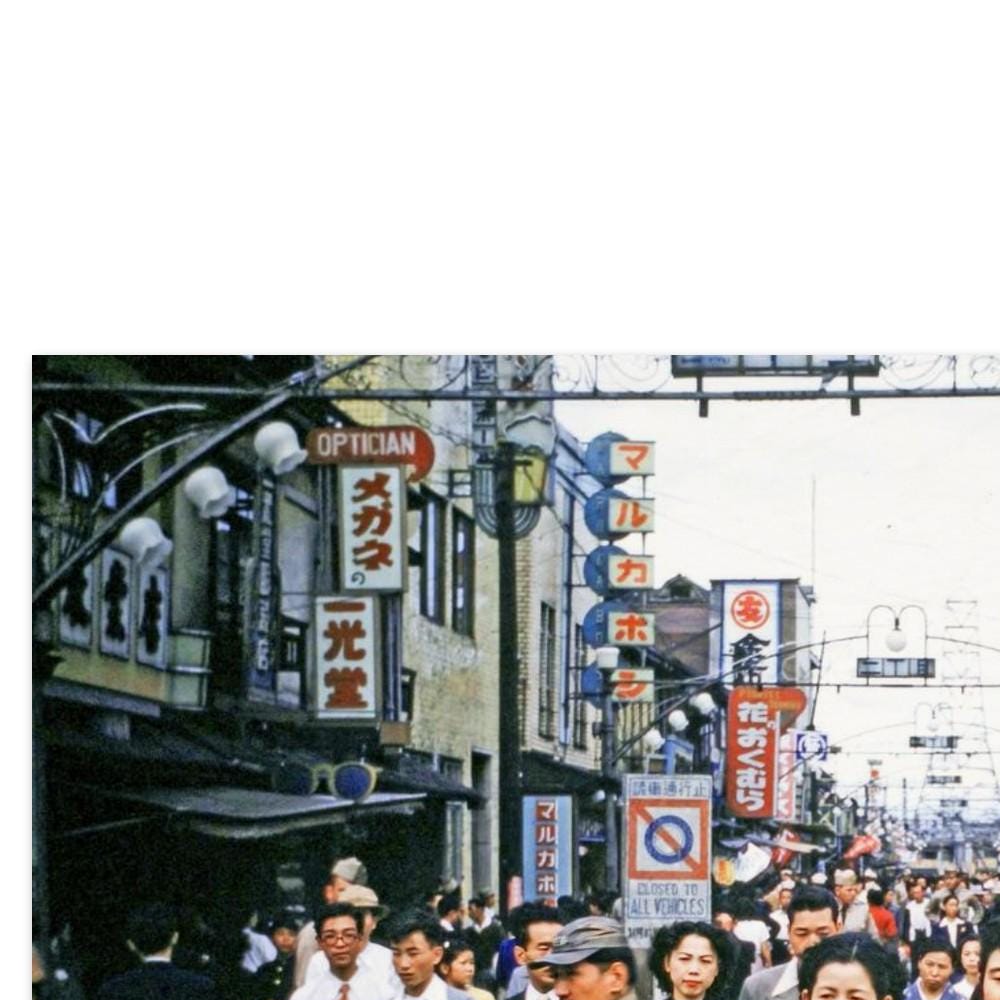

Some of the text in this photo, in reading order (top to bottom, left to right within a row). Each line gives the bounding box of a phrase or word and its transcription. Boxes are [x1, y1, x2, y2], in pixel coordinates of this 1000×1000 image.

[317, 432, 416, 457] OPTICIAN
[351, 472, 393, 585] メガネの
[323, 601, 368, 709] 一光堂
[637, 882, 698, 896] CLOSED TO
[630, 898, 705, 915] ALL VEHICLES
